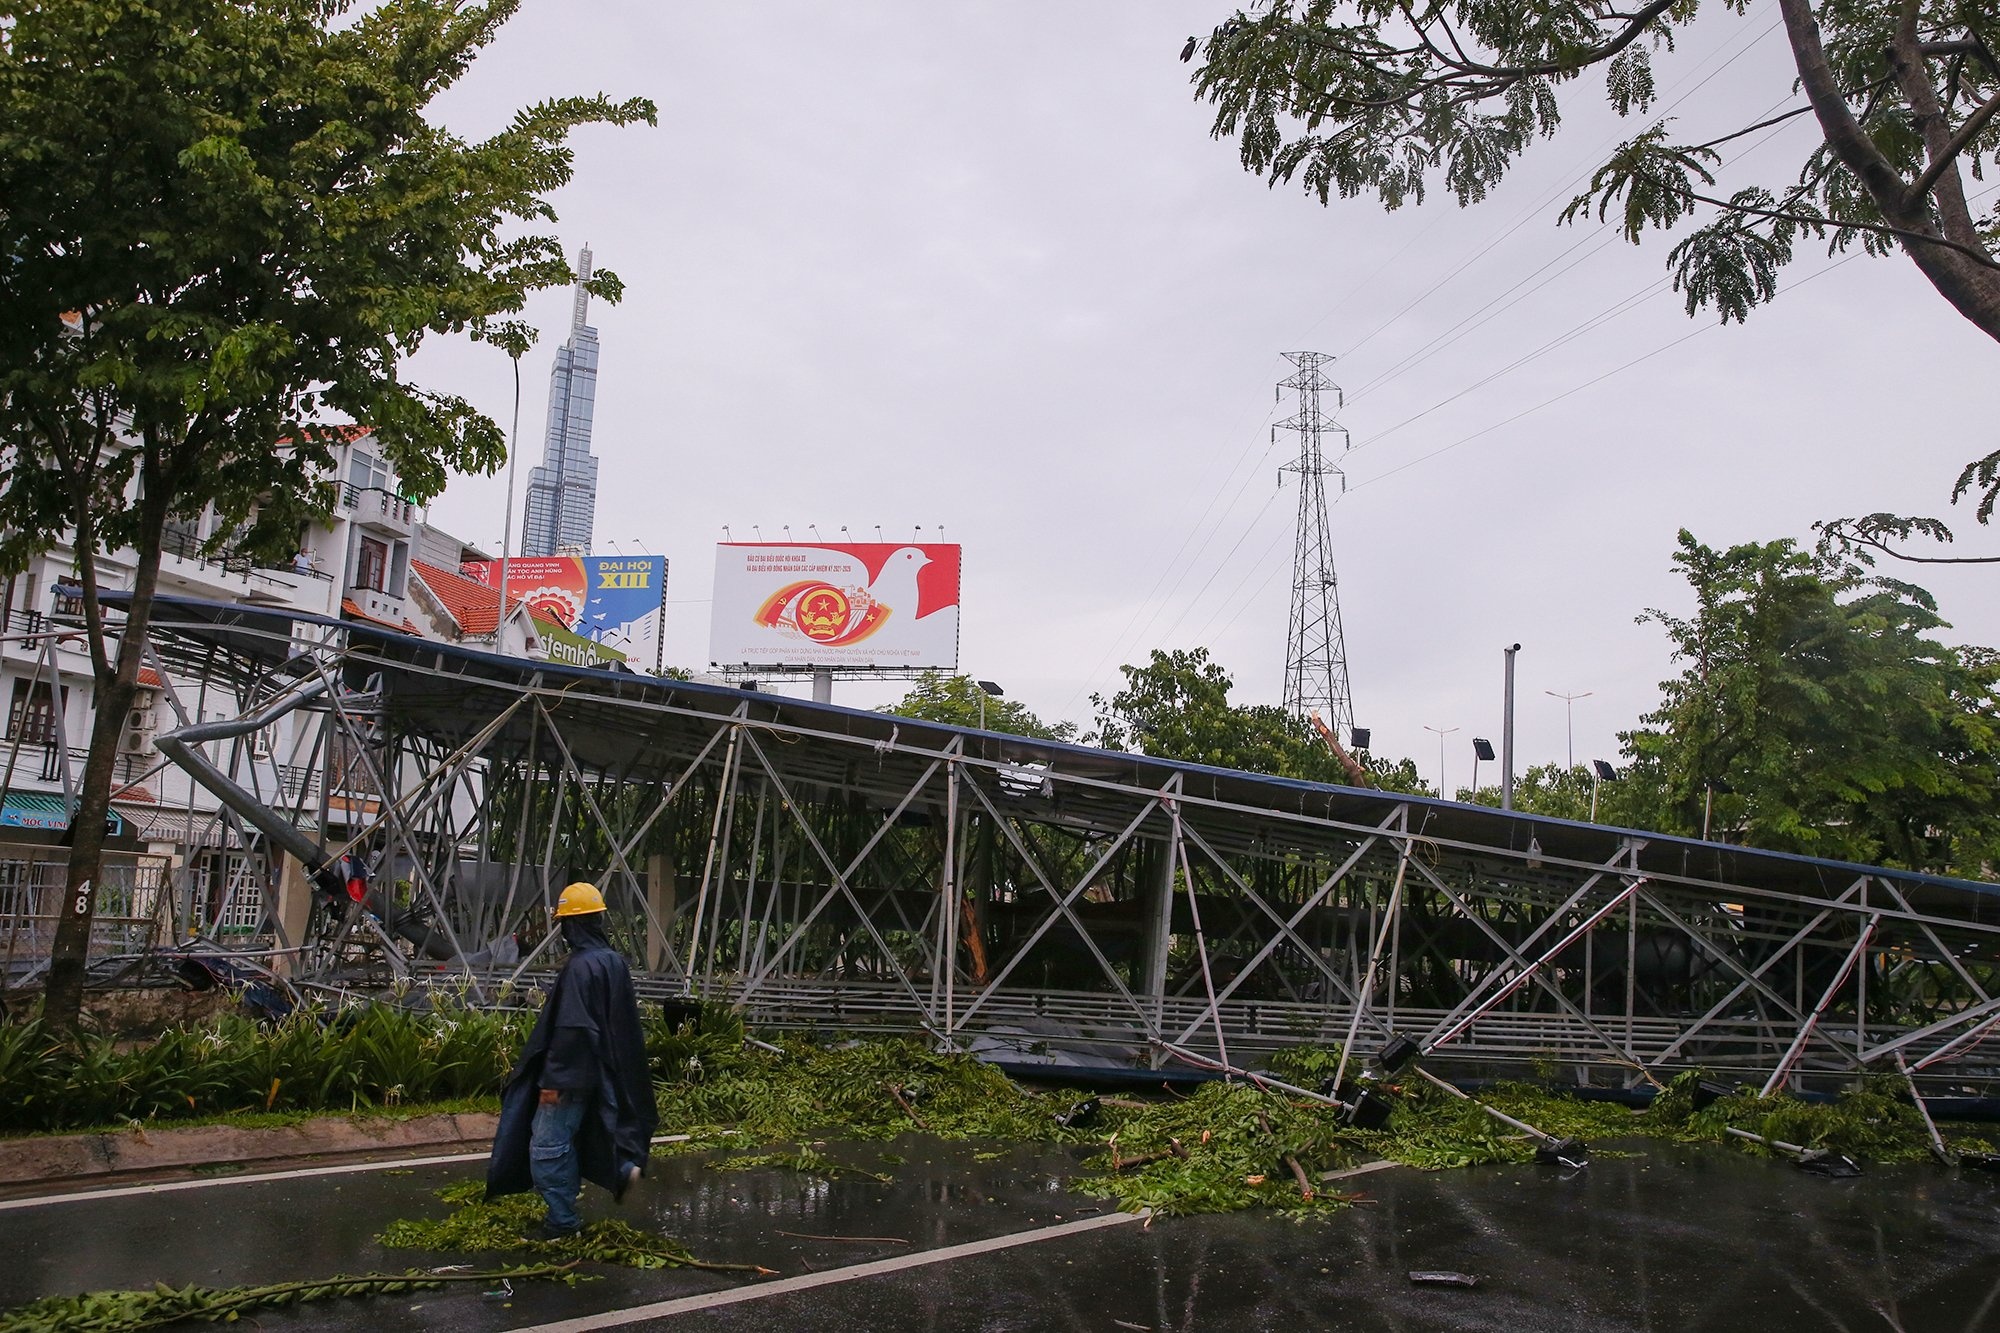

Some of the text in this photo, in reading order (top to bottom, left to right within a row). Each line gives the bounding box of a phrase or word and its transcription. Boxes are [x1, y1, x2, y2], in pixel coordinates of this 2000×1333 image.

[599, 560, 652, 572] ĐẠI HỘI
[597, 572, 651, 588] XIII
[22, 818, 43, 827] MỘC
